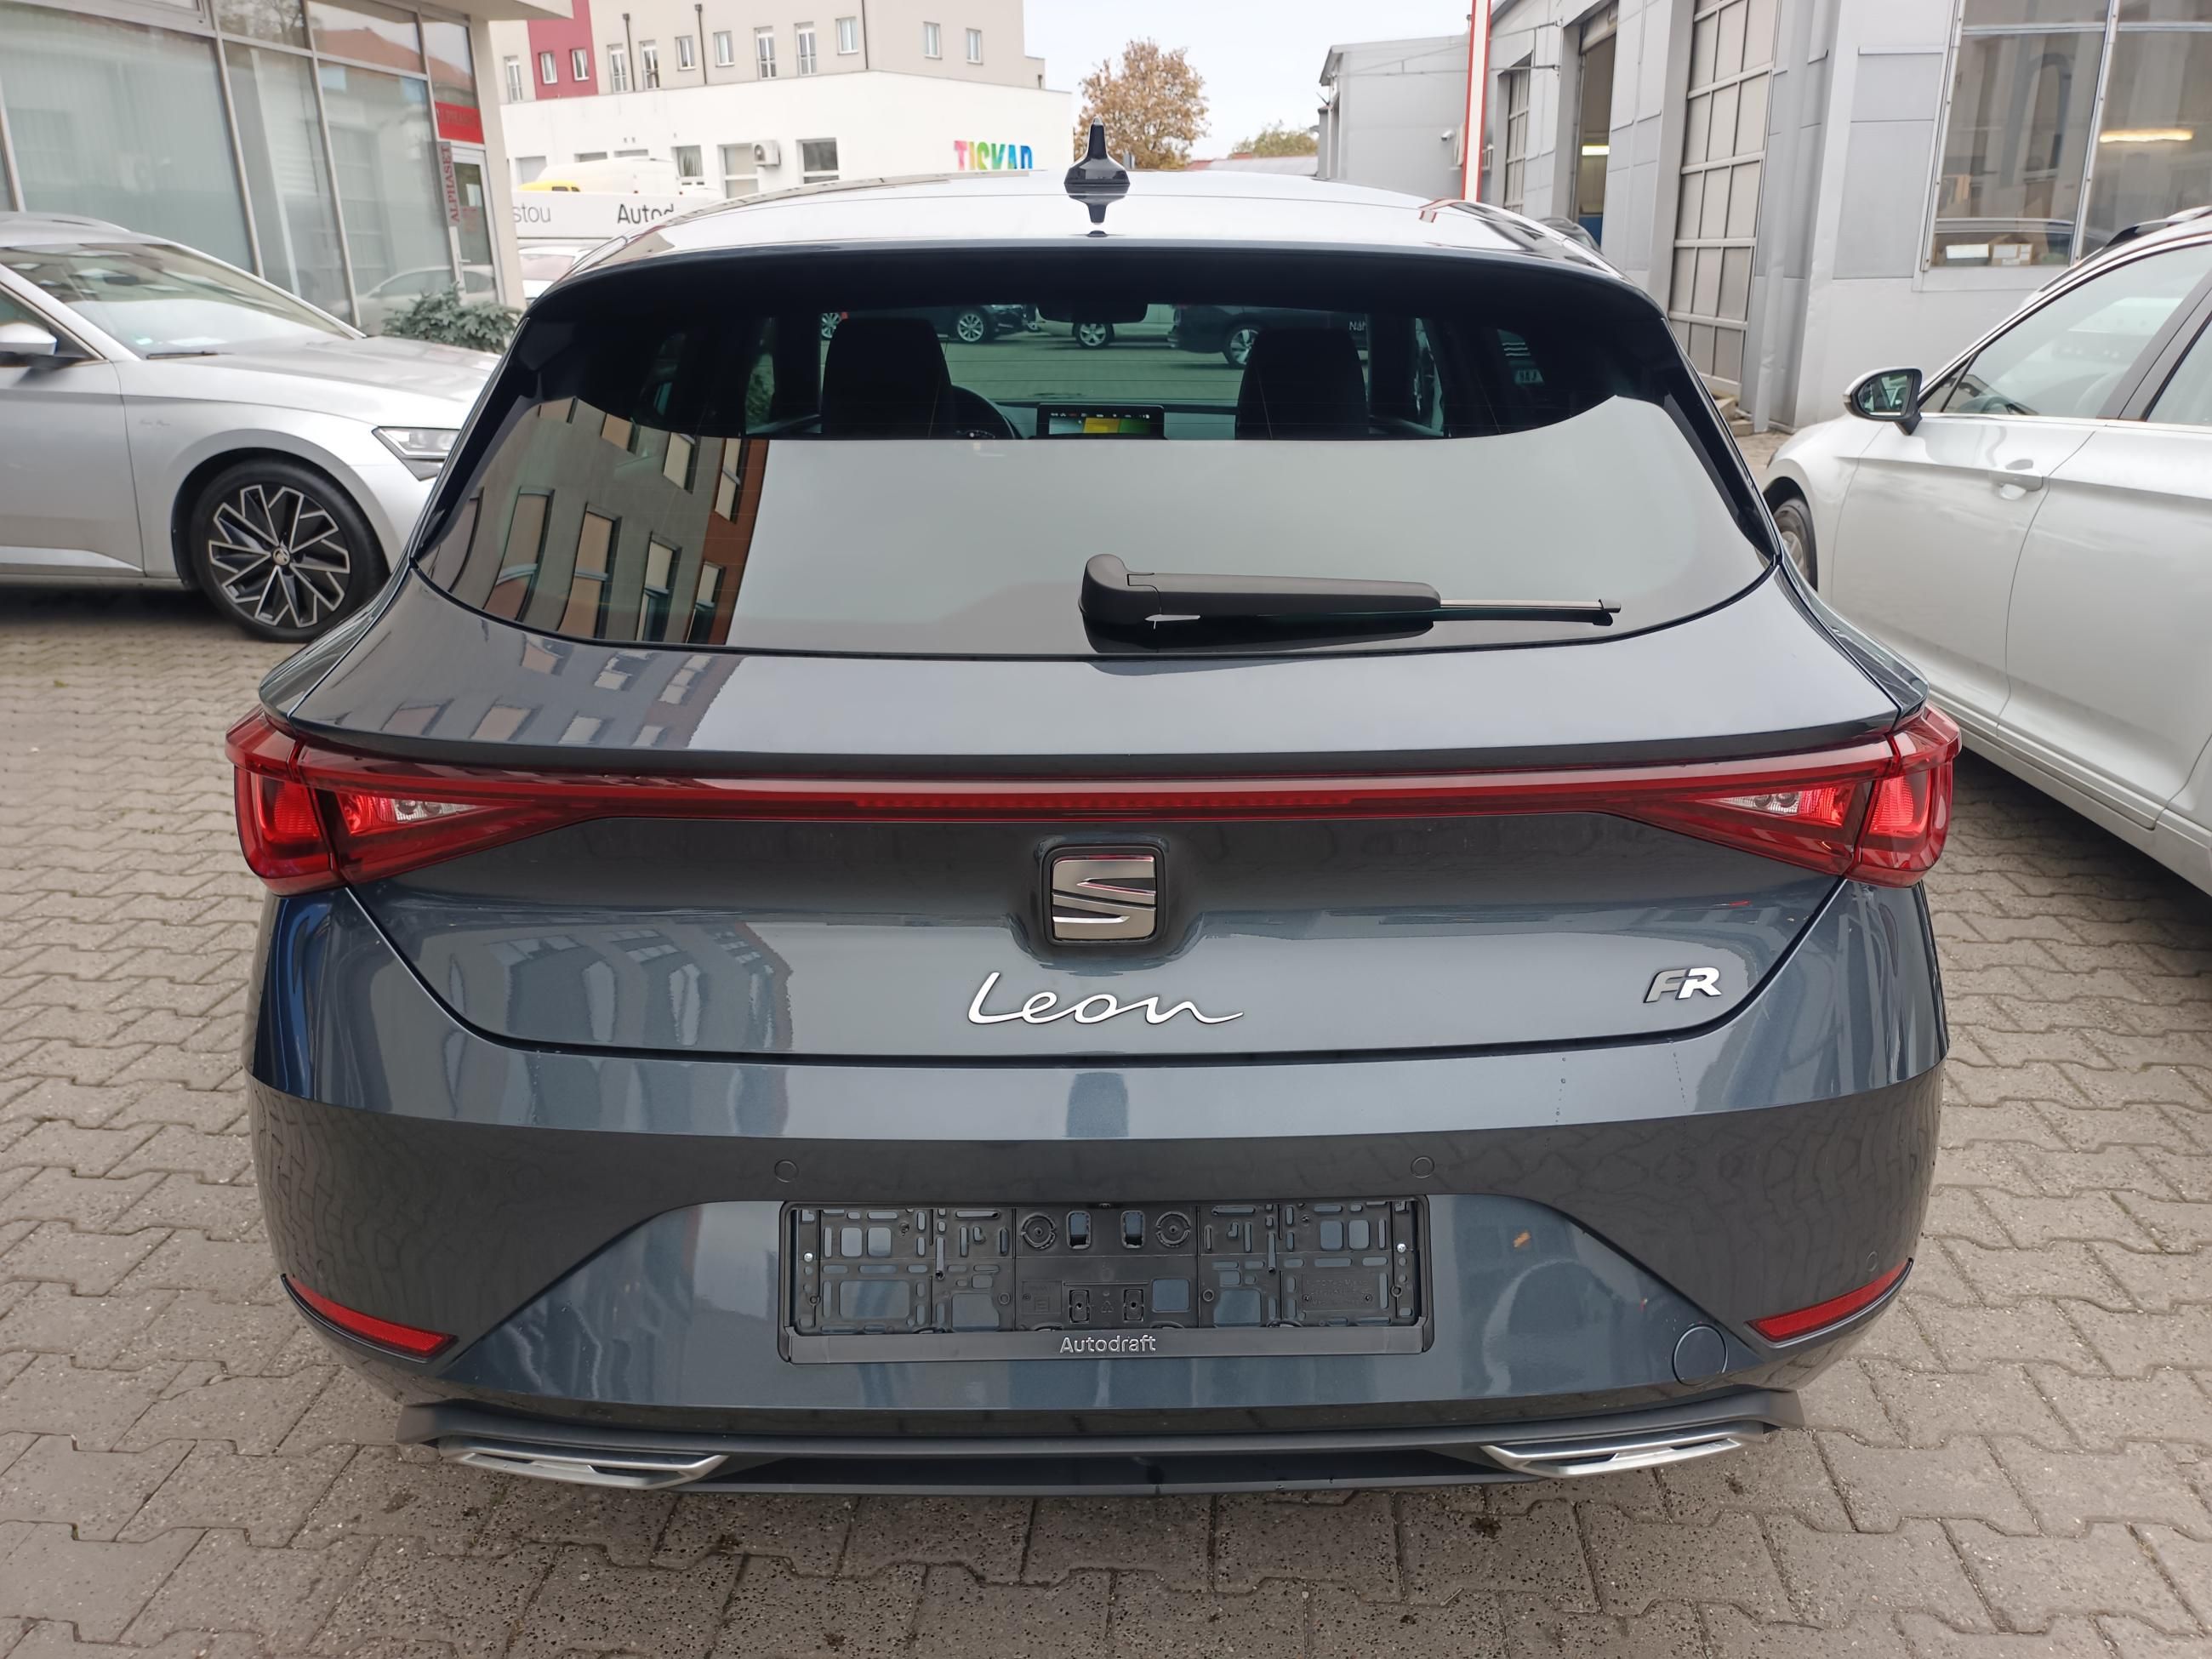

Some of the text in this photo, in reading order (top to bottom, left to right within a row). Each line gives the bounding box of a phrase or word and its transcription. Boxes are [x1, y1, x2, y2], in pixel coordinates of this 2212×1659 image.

[441, 145, 460, 223] ALPHASET
[967, 972, 1244, 1024] Leon
[1643, 966, 1722, 1003] FR
[1059, 1334, 1156, 1354] Autodraft
